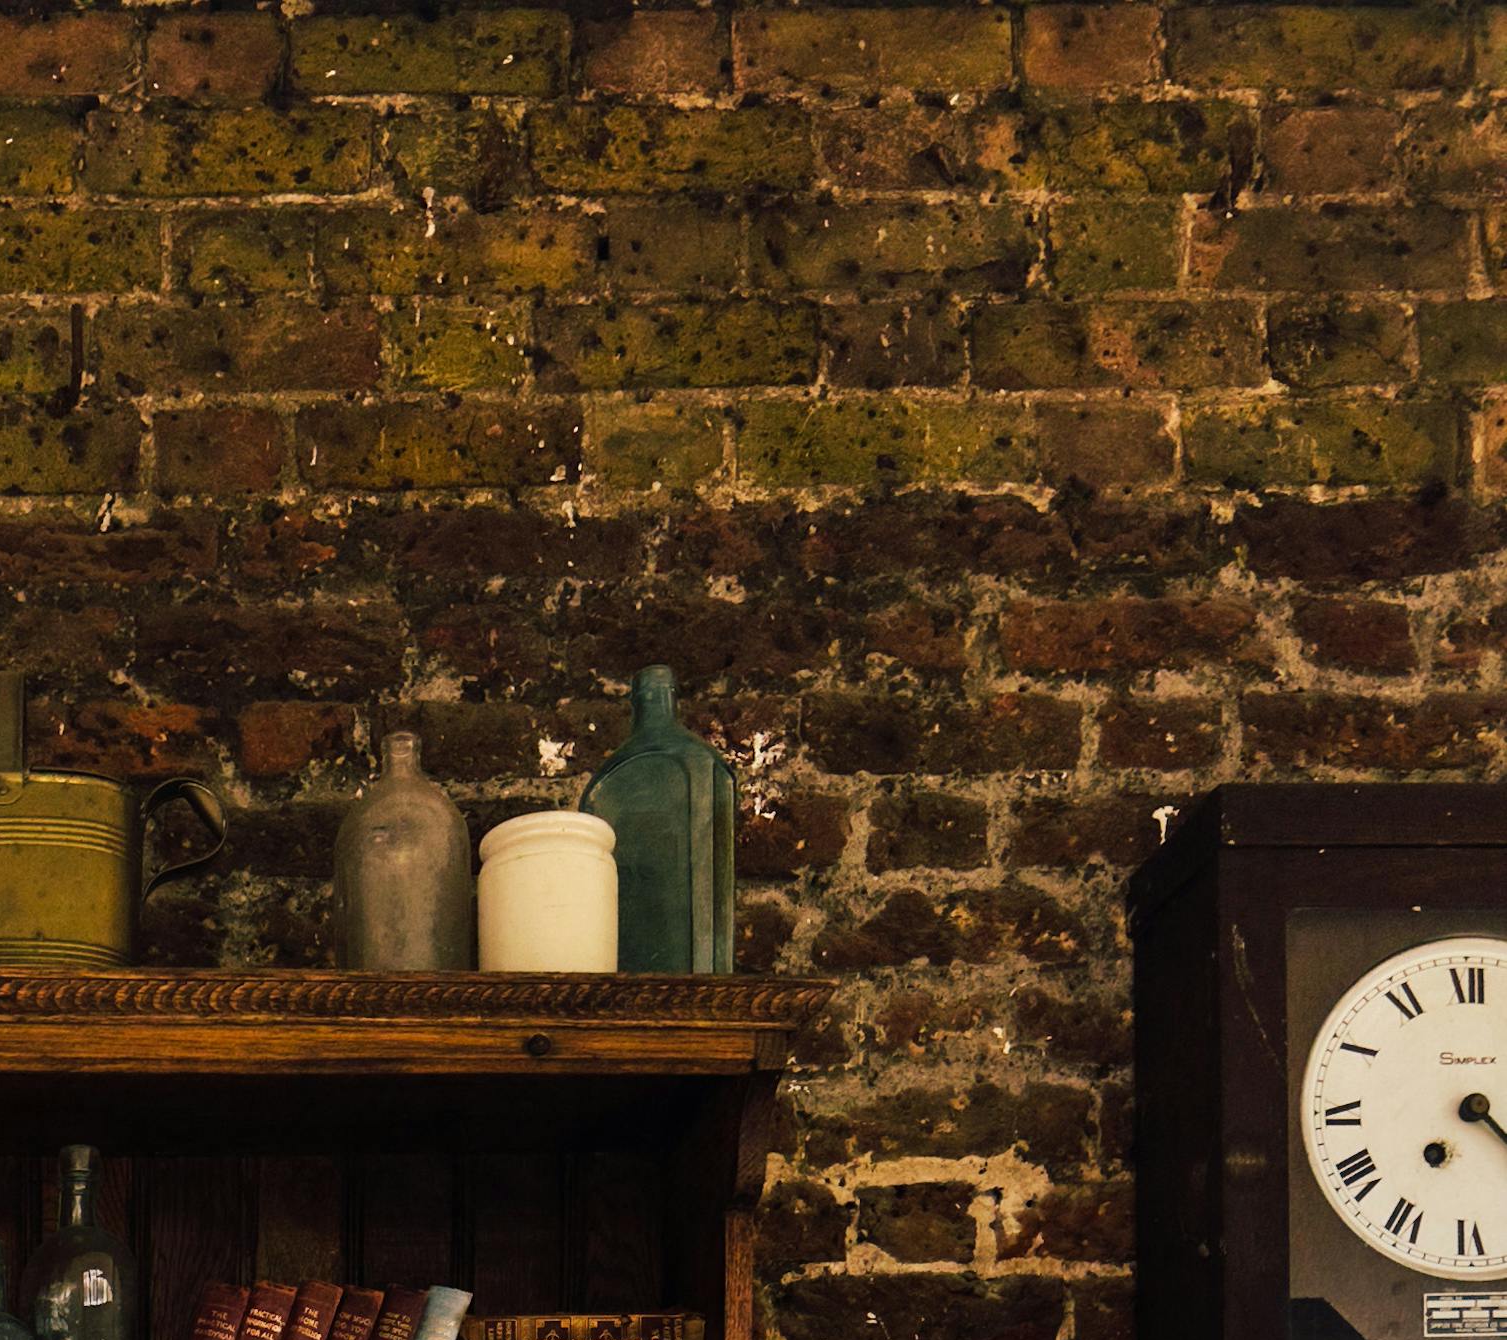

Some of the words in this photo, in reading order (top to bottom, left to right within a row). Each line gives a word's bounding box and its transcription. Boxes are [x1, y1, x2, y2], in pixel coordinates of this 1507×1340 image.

[1448, 967, 1485, 1004] XII
[1439, 1052, 1497, 1065] SIMPLEX
[1457, 1219, 1485, 1256] VI
[246, 1327, 260, 1338] FOR
[261, 1330, 274, 1340] ALL
